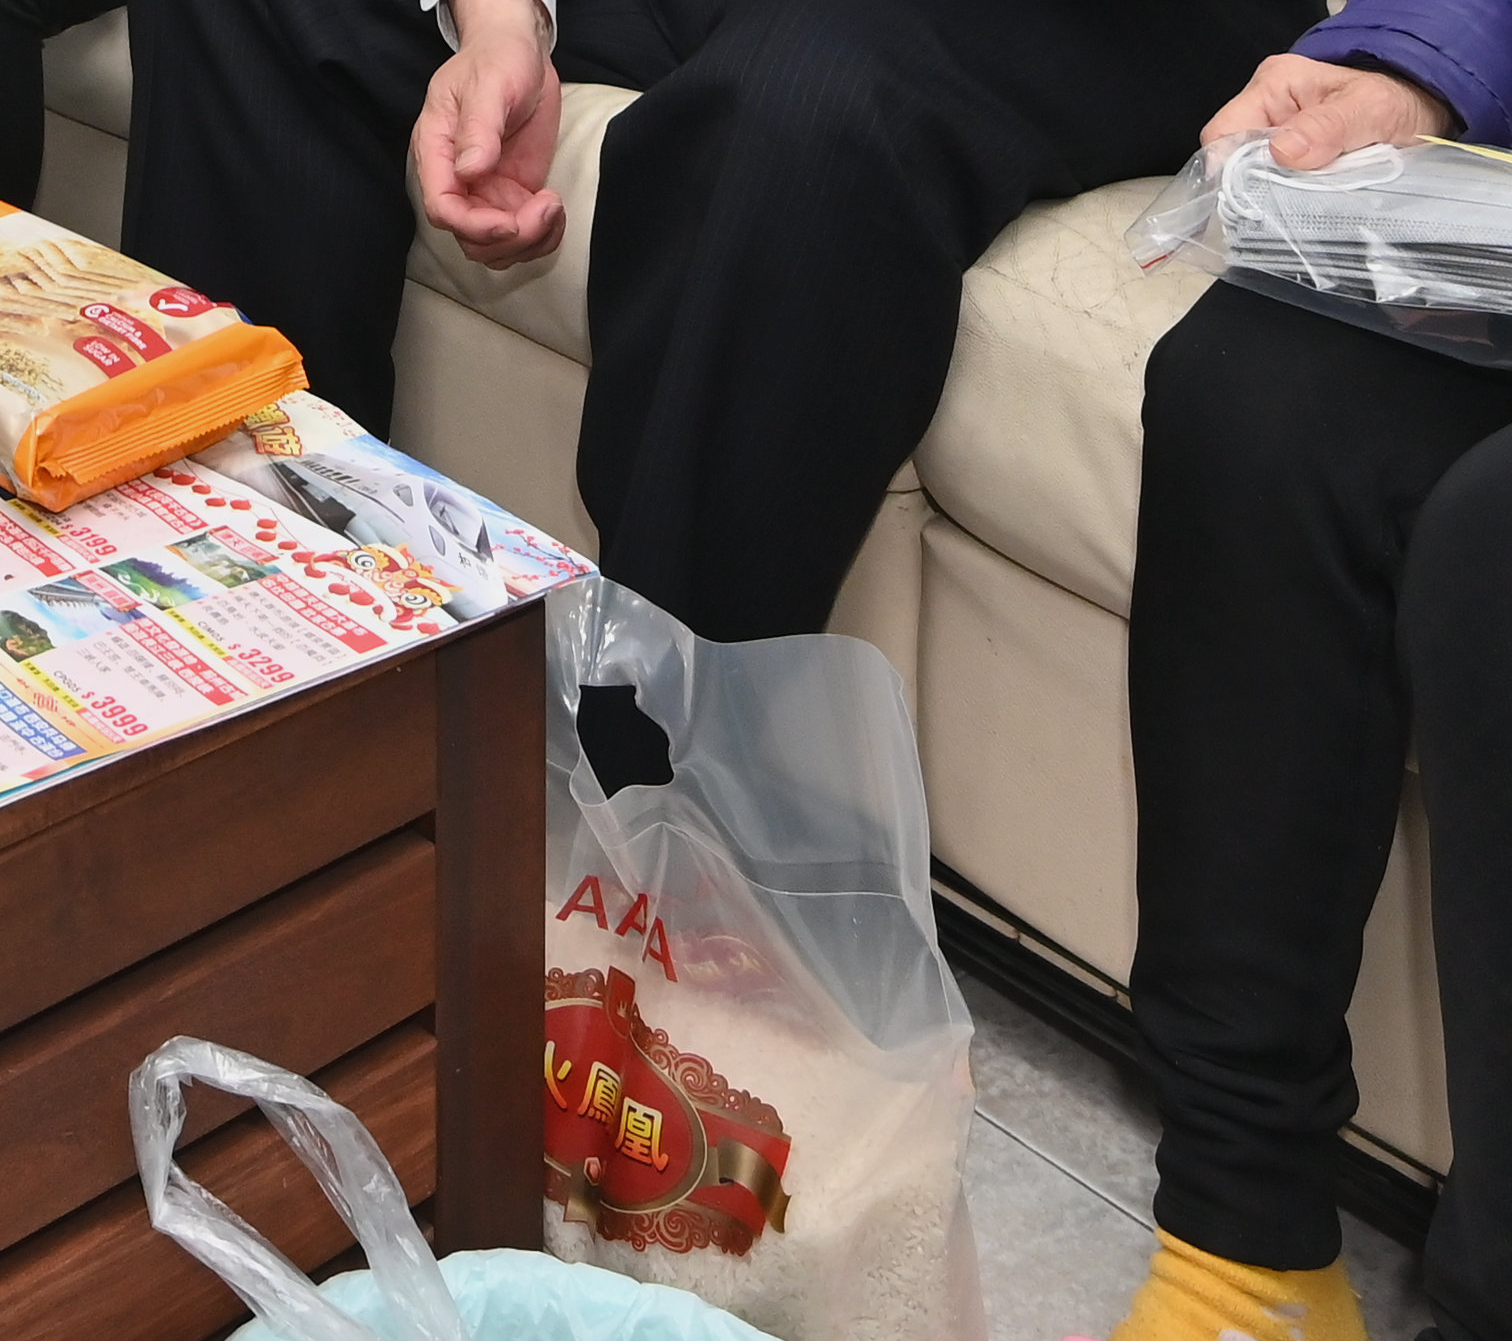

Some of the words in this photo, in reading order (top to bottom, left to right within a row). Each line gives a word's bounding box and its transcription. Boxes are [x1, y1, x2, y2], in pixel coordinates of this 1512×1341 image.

[69, 525, 118, 556] 3199
[237, 648, 295, 684] 3299
[91, 695, 149, 737] 3999
[555, 874, 679, 984] AAA
